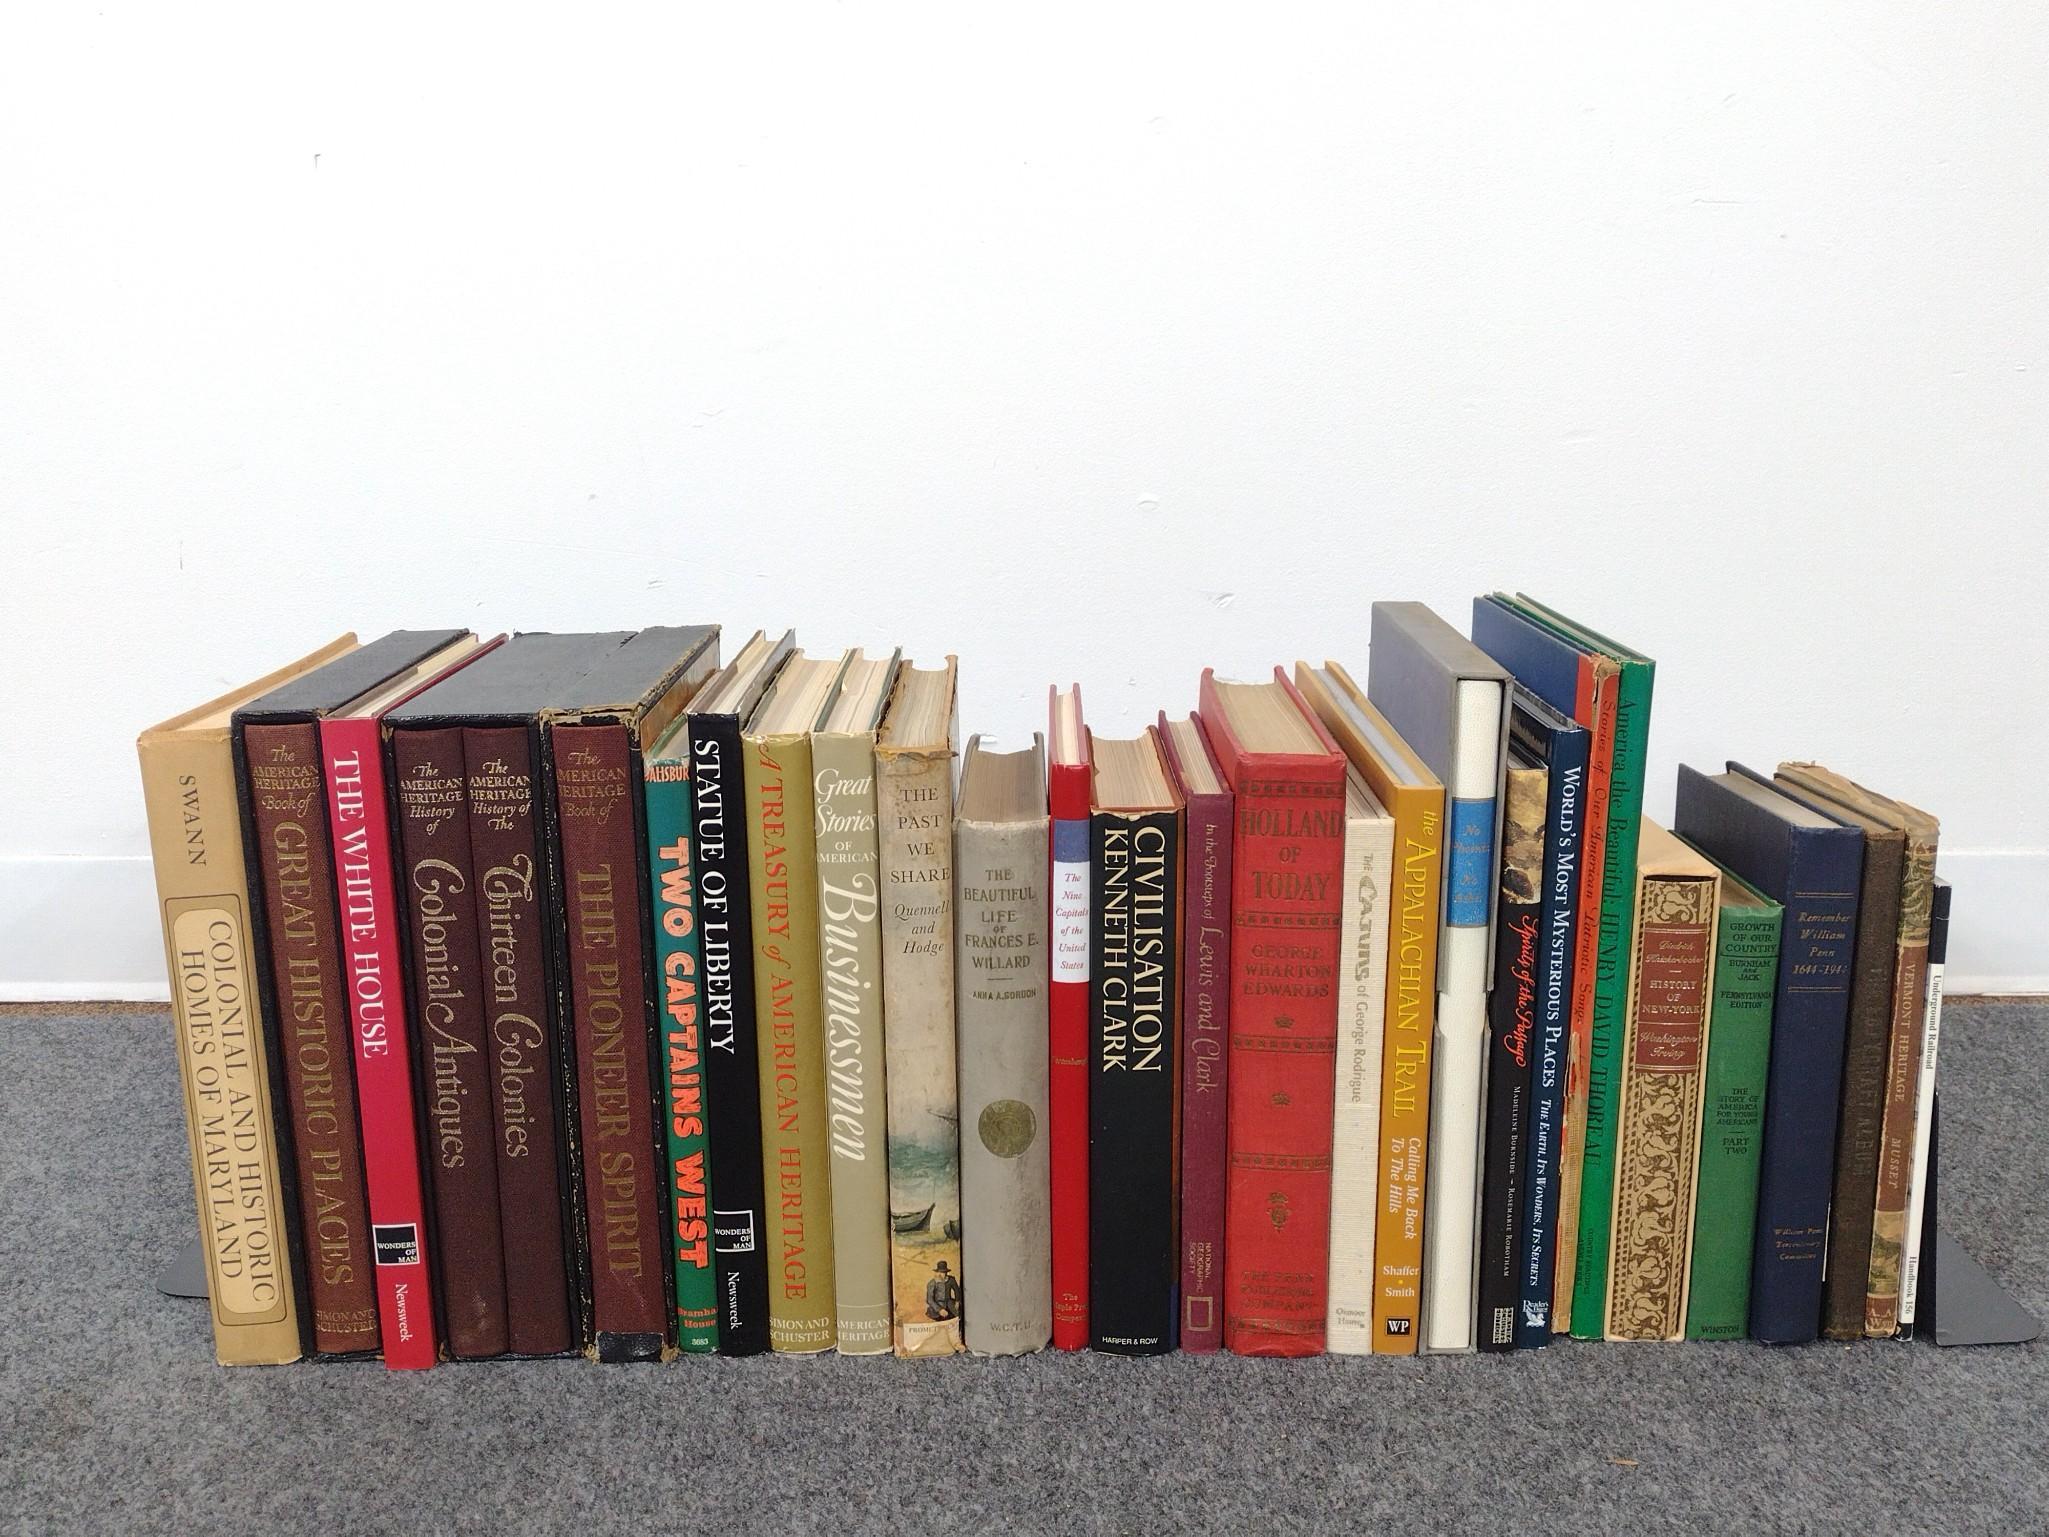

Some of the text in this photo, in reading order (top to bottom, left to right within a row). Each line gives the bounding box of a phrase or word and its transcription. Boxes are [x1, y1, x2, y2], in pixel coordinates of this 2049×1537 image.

[1614, 701, 1636, 771] America
[272, 745, 295, 762] The
[252, 765, 318, 778] AMERICAN
[412, 762, 439, 777] The
[482, 758, 509, 774] The
[253, 776, 320, 790] HERITAGE
[400, 777, 463, 790] AMERICAN
[470, 775, 532, 788] AMERICAN
[814, 768, 873, 804] Great
[400, 790, 464, 804] HERITAGE
[470, 788, 532, 800] HERITAGE
[900, 788, 938, 802] THE
[1612, 781, 1632, 808] the
[409, 805, 456, 819] History
[473, 802, 516, 817] History
[178, 775, 206, 866] SWANN
[488, 816, 514, 830] The
[816, 804, 877, 838] Stories
[898, 814, 943, 830] PAST
[1240, 808, 1344, 838] HOLLAND
[834, 841, 852, 851] OF
[906, 842, 935, 856] WE
[1278, 846, 1300, 864] OF
[1574, 700, 1616, 1024] Stories Our American Patriotic Songs
[890, 867, 950, 884] SHARE
[985, 869, 1013, 881] THE
[1064, 873, 1081, 882] The
[964, 886, 1035, 902] BEAUTIFUL
[1252, 872, 1330, 901] TODAY
[694, 739, 735, 1054] STATUE OF LIBERTY
[1062, 891, 1082, 900] Nine
[332, 751, 388, 1059] THE WHITE HOUSE
[894, 900, 950, 922] Quennell
[1056, 908, 1089, 918] Capitals
[982, 910, 1016, 922] LIFE
[1798, 912, 1851, 922] Remember
[911, 922, 935, 936] and
[1542, 766, 1582, 1088] WORLD'S MOST MYSTERIOUS PLACES
[1730, 922, 1775, 932] GROWTH
[1800, 930, 1846, 940] William
[965, 934, 1022, 948] FRANCES
[1508, 915, 1538, 968] Spirits
[1733, 934, 1772, 942] OF OUR
[902, 940, 944, 956] Hodge
[1058, 943, 1086, 952] United
[1102, 828, 1129, 1072] KENNETH CLARK
[1132, 826, 1166, 1072] CIVILISATION
[1251, 944, 1322, 960] GEORGE
[1598, 913, 1620, 982] HENRY
[1726, 944, 1777, 953] COUNTRY
[1808, 946, 1835, 957] Penn
[972, 956, 1030, 970] WILLARD
[1060, 960, 1084, 970] States
[1244, 964, 1331, 978] WHARTON
[1393, 810, 1439, 1118] the APPALACHIAN TRAIL
[1728, 960, 1771, 968] BURNHAM
[1192, 856, 1224, 1094] Footsteps Lewis and Clark
[1244, 982, 1328, 997] EDWARDS
[1650, 980, 1698, 990] HISTORY
[1666, 993, 1681, 1002] OF
[413, 858, 478, 1168] Colonial Antiques
[483, 854, 544, 1158] Thirteen Colonies
[1642, 1004, 1700, 1014] NEW-YORK
[758, 743, 807, 1300] A TREASURY of AMERICAN HERITAGE
[823, 872, 877, 1161] Businessmen
[1352, 1002, 1368, 1045] George
[1925, 974, 1942, 1070] Underground Railroad
[1591, 994, 1615, 1058] DAVID
[1896, 964, 1916, 1102] VERMONT HERITAGE
[1640, 1032, 1697, 1046] Washington
[273, 821, 354, 1288] GREAT HISTORIC PLACES
[658, 836, 710, 1269] TWO CAPTAINS WEST
[1650, 1046, 1686, 1059] Irving
[577, 864, 642, 1278] THE PIONEER SPIRIT
[1350, 1046, 1366, 1102] Rodrigue
[181, 951, 243, 1278] HOMES OF MARYLAND
[208, 920, 276, 1302] COLONIAL AND HISTORIC
[1584, 1068, 1608, 1166] THOREAU
[1722, 1138, 1750, 1146] PART
[1725, 1146, 1748, 1154] TWO
[1886, 1138, 1902, 1190] MUSSEY
[1388, 1138, 1404, 1214] To The Hills
[1504, 1086, 1521, 1278] MADELEINE BURNSIDE ROSEMARIE ROBOTHAM
[1404, 1138, 1422, 1239] Calling Me Back
[1529, 1100, 1552, 1286] THE EARTH, WONDERS, SECRETS
[376, 1240, 416, 1250] WONDERS
[1382, 1266, 1420, 1276] Shaffer
[1906, 1256, 1918, 1298] Handbook
[728, 1271, 742, 1330] Newsweek
[1385, 1288, 1415, 1297] Smith
[395, 1283, 414, 1342] Newsweek
[770, 1316, 830, 1330] SIMON AND
[1388, 1320, 1410, 1333] WP
[1700, 1324, 1740, 1334] WINSTON
[770, 1330, 830, 1343] SCHUSTER
[1102, 1336, 1132, 1345] HARPER
